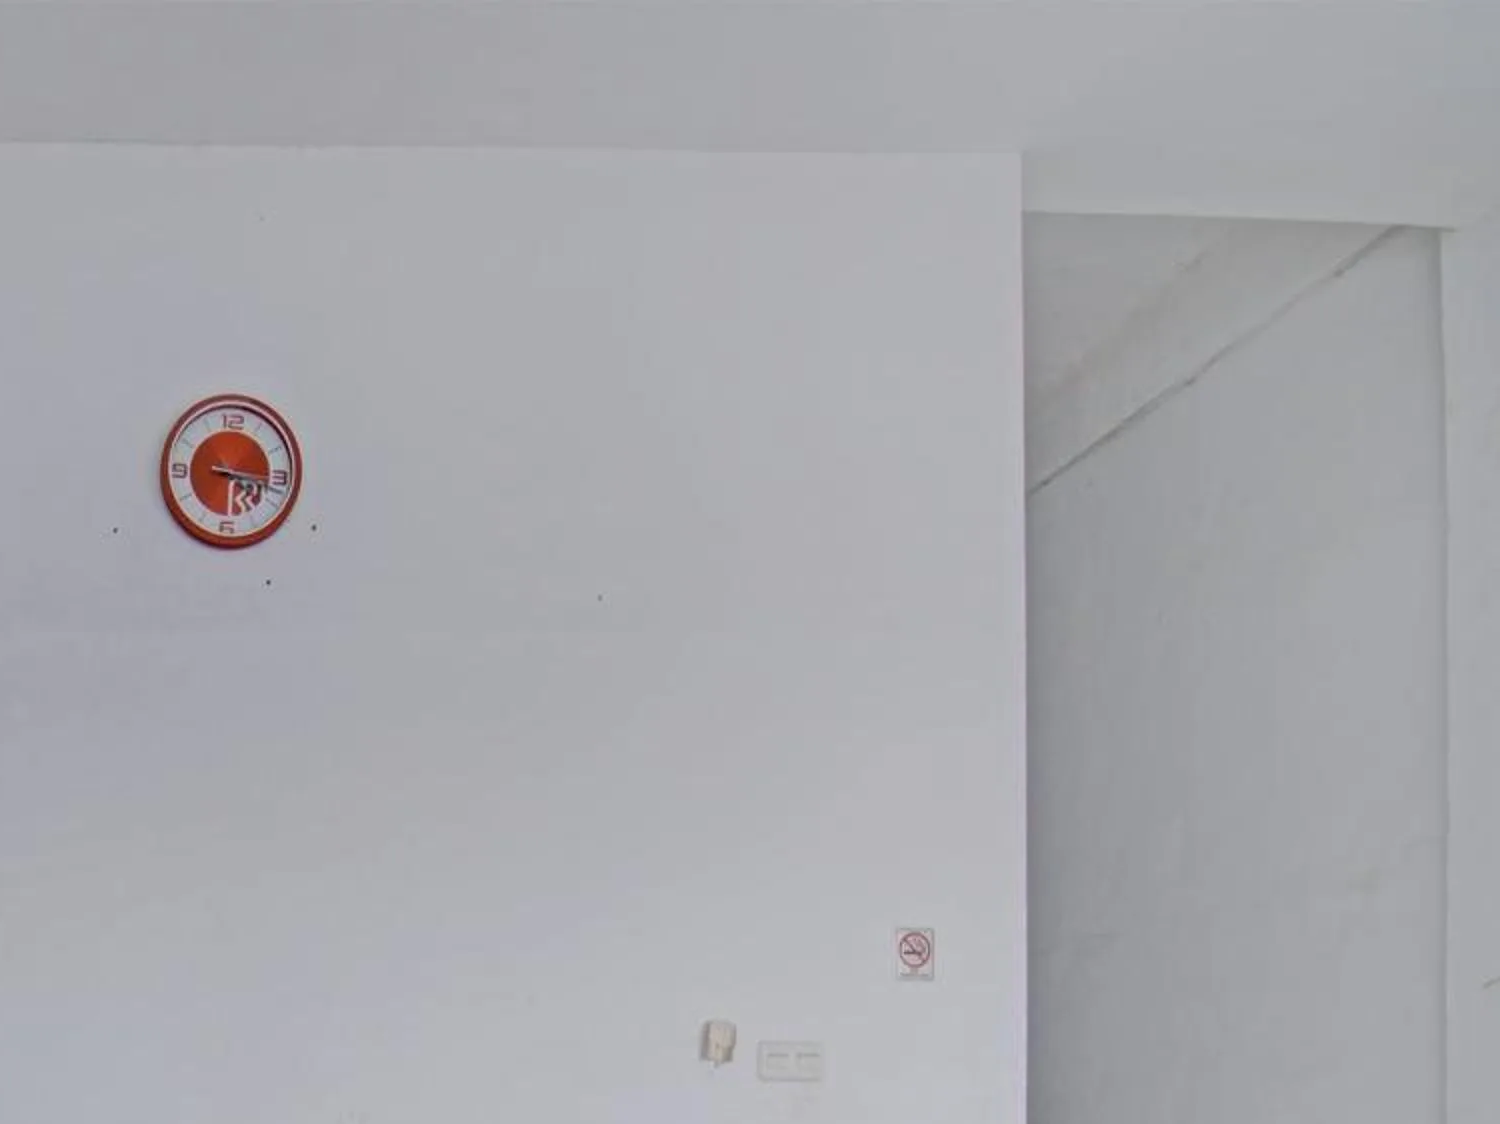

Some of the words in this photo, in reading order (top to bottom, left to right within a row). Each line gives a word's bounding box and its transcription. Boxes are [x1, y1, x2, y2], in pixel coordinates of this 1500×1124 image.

[222, 414, 245, 430] 12
[172, 463, 188, 479] 9
[272, 469, 288, 485] 3
